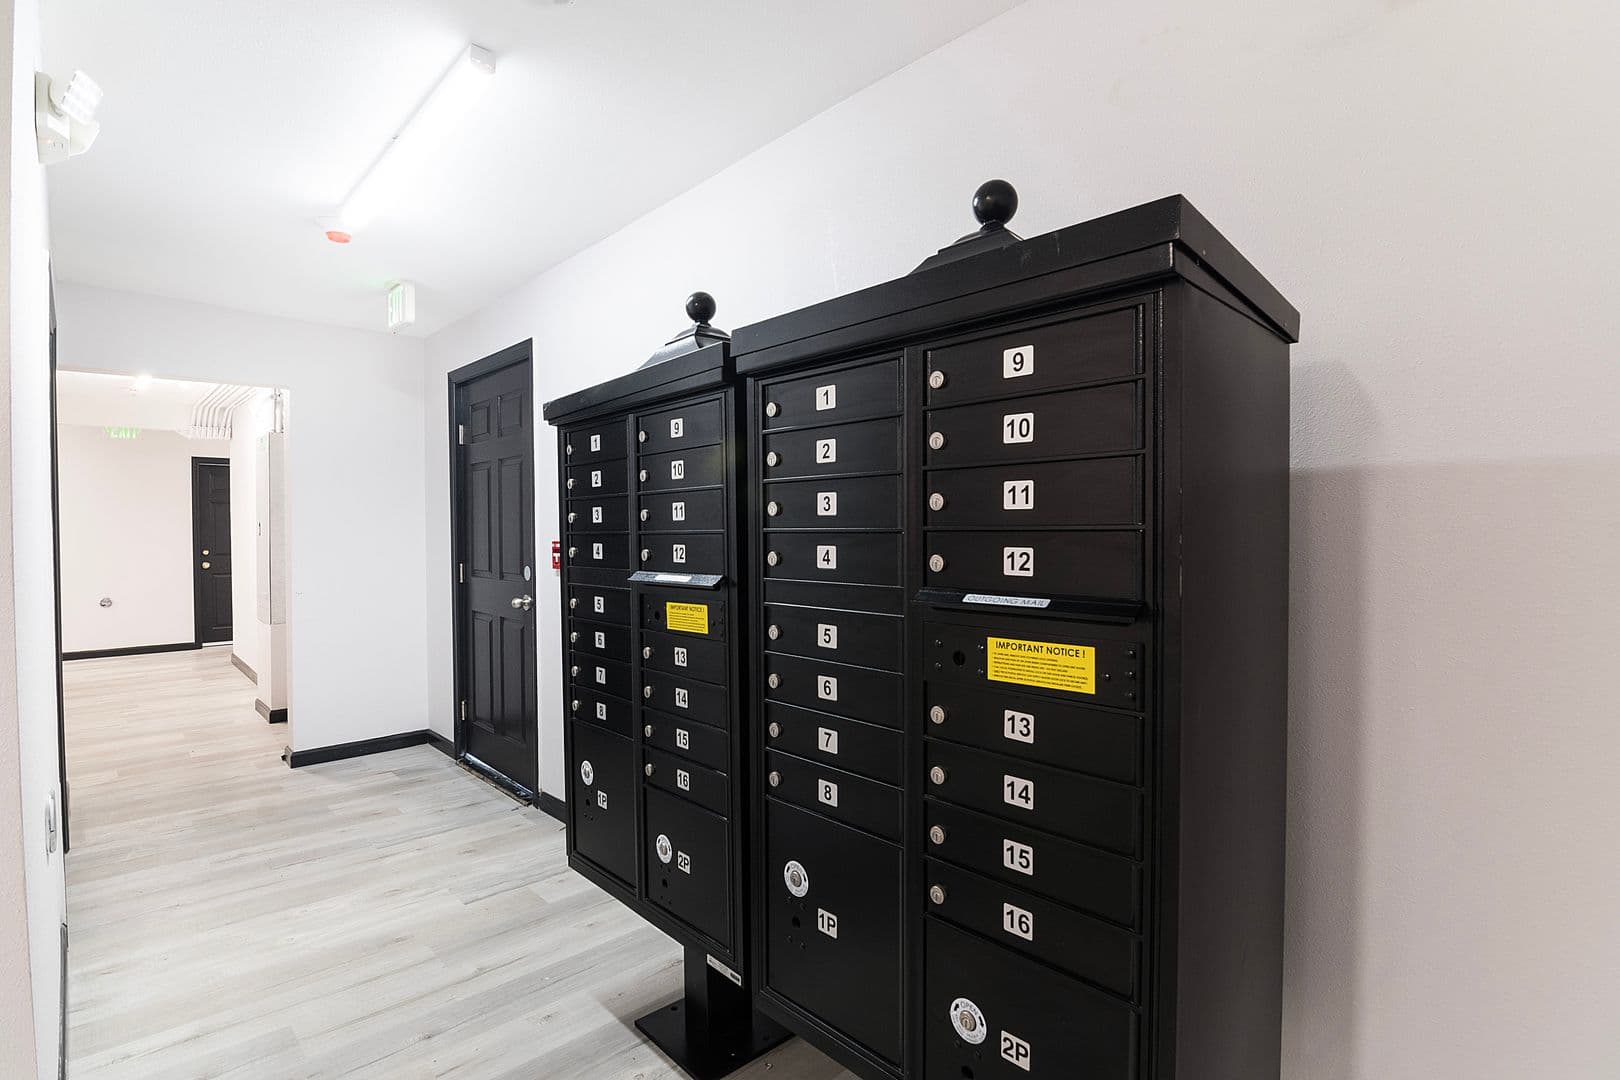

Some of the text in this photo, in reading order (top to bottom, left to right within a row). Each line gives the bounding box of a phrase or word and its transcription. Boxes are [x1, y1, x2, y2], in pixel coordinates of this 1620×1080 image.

[1012, 352, 1025, 372] 9
[823, 389, 829, 406] 1
[1006, 418, 1030, 439] 10
[822, 443, 830, 460] 2
[673, 463, 683, 476] 10
[1007, 484, 1029, 505] 11
[674, 505, 683, 518] 11
[823, 495, 831, 512] 3
[674, 547, 685, 560] 12
[822, 549, 831, 565] 4
[1006, 551, 1031, 572] 12
[966, 595, 1048, 607] OUTGOING MAIL
[823, 627, 832, 644] 5
[675, 650, 686, 665] 13
[995, 640, 1044, 655] IMPORTANT
[1046, 647, 1080, 658] NOTICE
[823, 679, 832, 696] 6
[676, 690, 687, 705] 14
[1007, 714, 1031, 738] 13
[677, 731, 688, 747] 15
[823, 731, 832, 748] 7
[678, 772, 689, 788] 16
[823, 784, 832, 801] 8
[1006, 780, 1031, 805] 14
[678, 854, 690, 870] 2P
[1006, 845, 1031, 870] 15
[818, 913, 836, 932] 1P
[1006, 909, 1030, 935] 16
[960, 1000, 978, 1016] OPEN
[1002, 1036, 1029, 1062] 2P
